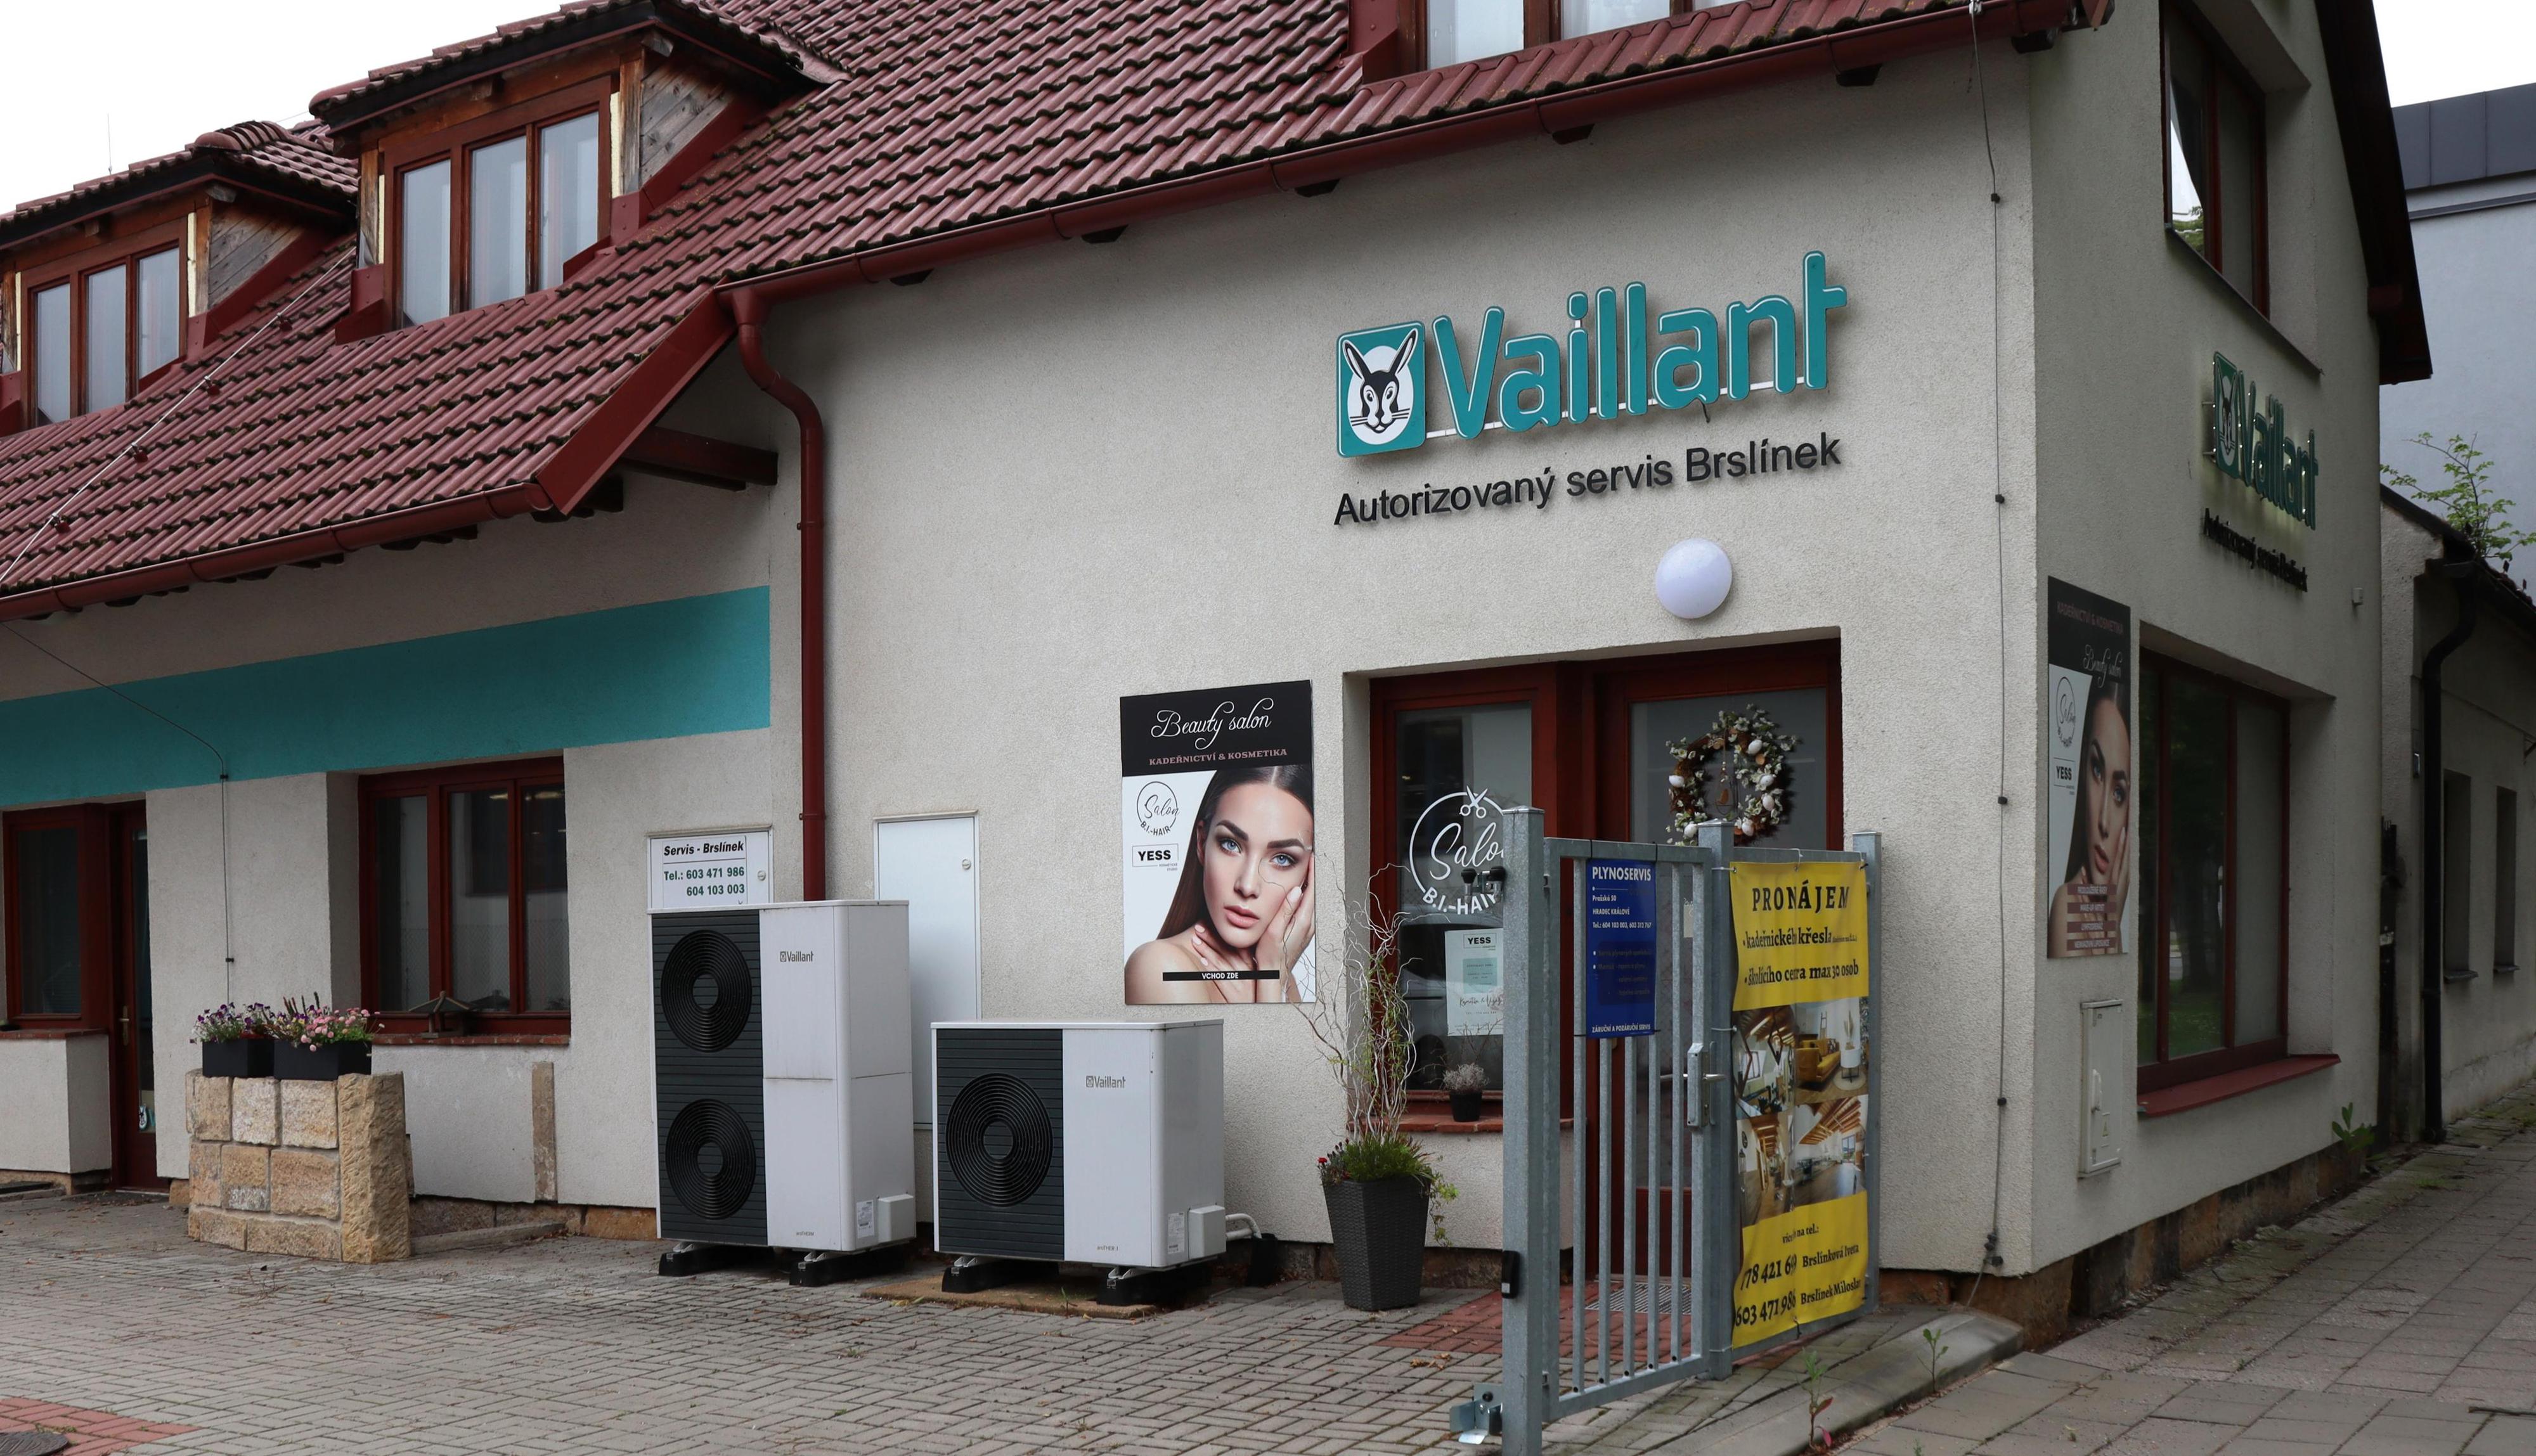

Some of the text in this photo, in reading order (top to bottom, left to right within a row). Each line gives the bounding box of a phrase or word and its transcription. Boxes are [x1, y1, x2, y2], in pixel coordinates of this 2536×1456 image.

[1432, 250, 1847, 440] Vaillant
[1333, 432, 1842, 525] Autorizovaný servis Brslínek
[1151, 697, 1274, 750] Beauty salon
[1148, 748, 1288, 766] KADEŘNICTVÍ & KOSMETIKA
[2056, 766, 2072, 780] YESS
[1144, 794, 1180, 819] Salon
[663, 844, 695, 857] Servis
[702, 841, 744, 854] Brslínek
[1137, 850, 1172, 861] YESS
[1429, 821, 1504, 880] Salo
[663, 866, 744, 881] Tel.: 603 471 986
[1592, 866, 1652, 882] PLYNOSERVIS
[686, 883, 745, 897] 604 103 003
[1610, 907, 1630, 915] KRÁLOVÉ
[1467, 937, 1491, 945] YESS
[1745, 927, 1797, 949] kadeřnickéh
[1798, 926, 1832, 944] křesla
[786, 950, 814, 963] Vaillant
[1201, 971, 1239, 980] VCHOD ZDE
[1784, 967, 1806, 982] cenra
[1809, 967, 1832, 979] max
[1832, 964, 1840, 979] 30
[1841, 958, 1859, 976] osob
[1592, 1024, 1611, 1033] ZÁRUČNÍ
[1615, 1022, 1638, 1032] POZÁRUČNÍ
[1094, 1076, 1126, 1088] Vaillant
[1761, 1260, 1782, 1284] 421
[1802, 1245, 1844, 1268] Brslínková
[1735, 1305, 1757, 1327] 603
[1760, 1298, 1780, 1322] 471
[1781, 1289, 1796, 1315] 986
[1801, 1284, 1834, 1305] Brslínek
